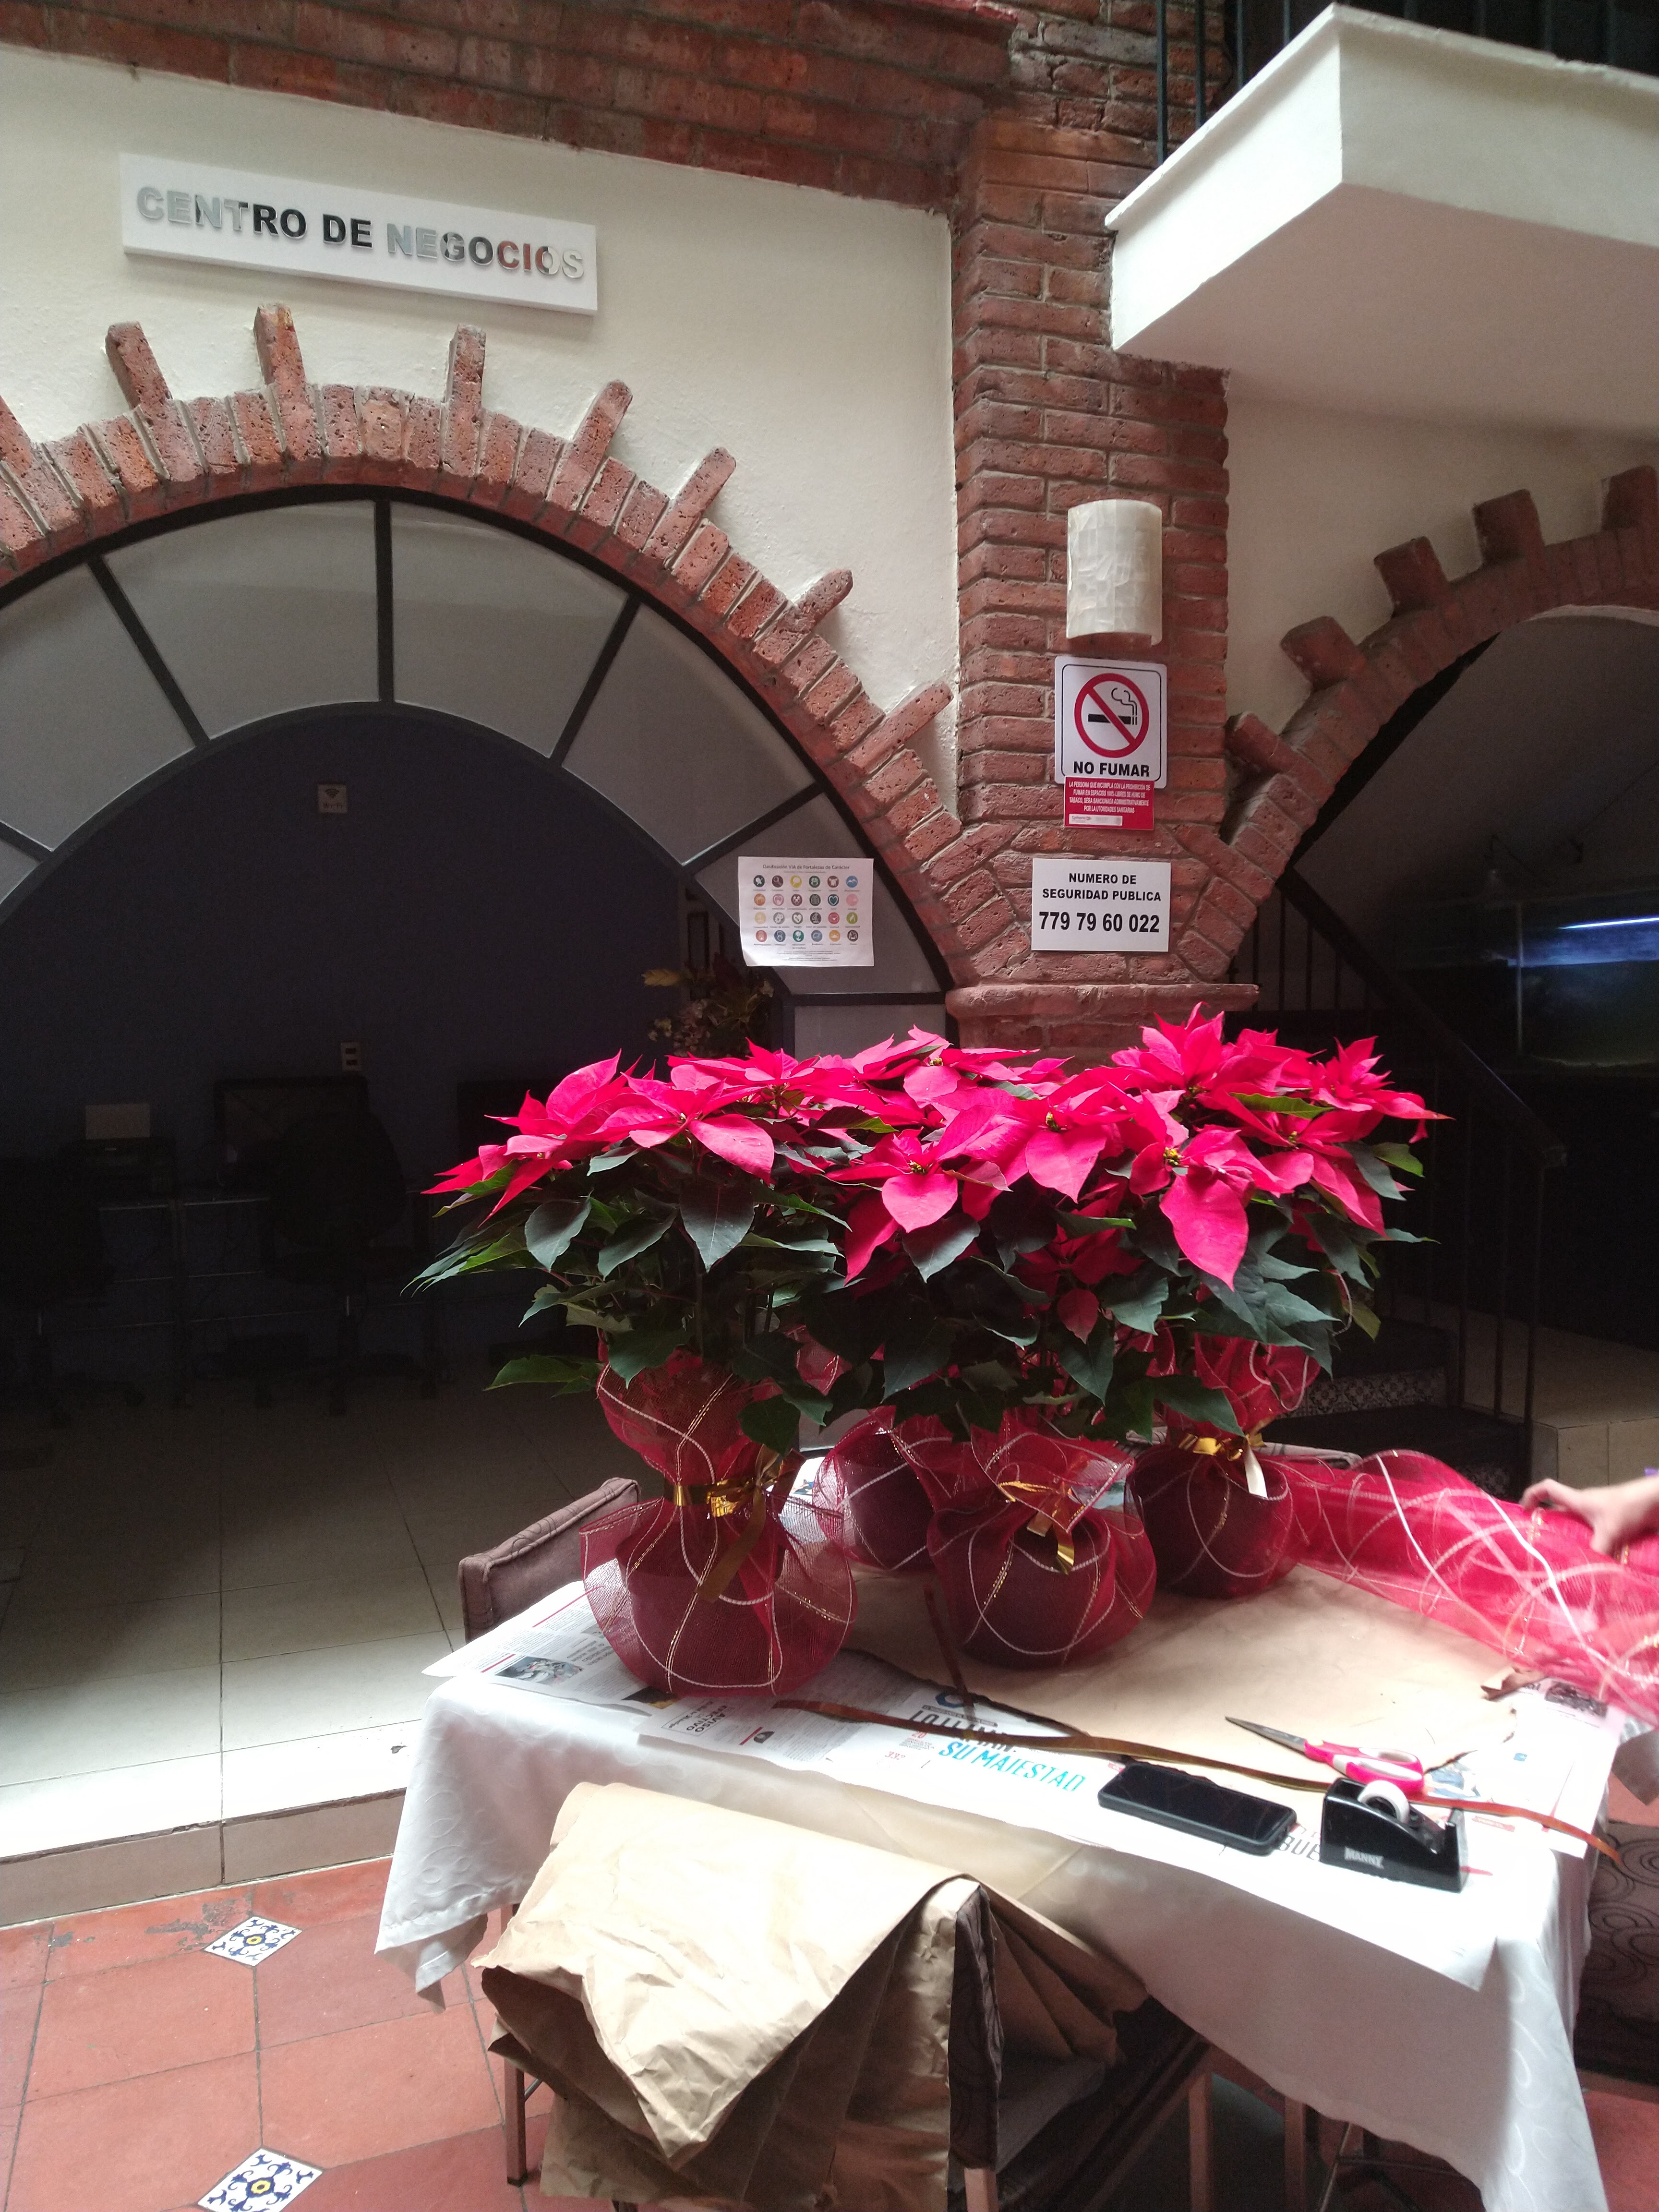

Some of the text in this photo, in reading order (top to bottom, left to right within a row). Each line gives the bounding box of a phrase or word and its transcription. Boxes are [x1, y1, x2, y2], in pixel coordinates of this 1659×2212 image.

[136, 186, 585, 279] CENTRO DE NEGOCIOS
[1073, 761, 1150, 777] NO FUMAR
[1069, 873, 1137, 885] NUMERO DE
[1042, 888, 1162, 902] SEGURIDAD PUBLICA
[1039, 912, 1160, 934] 779 79 60 022
[938, 1741, 977, 1760] SU
[1345, 1846, 1384, 1869] MANNY
